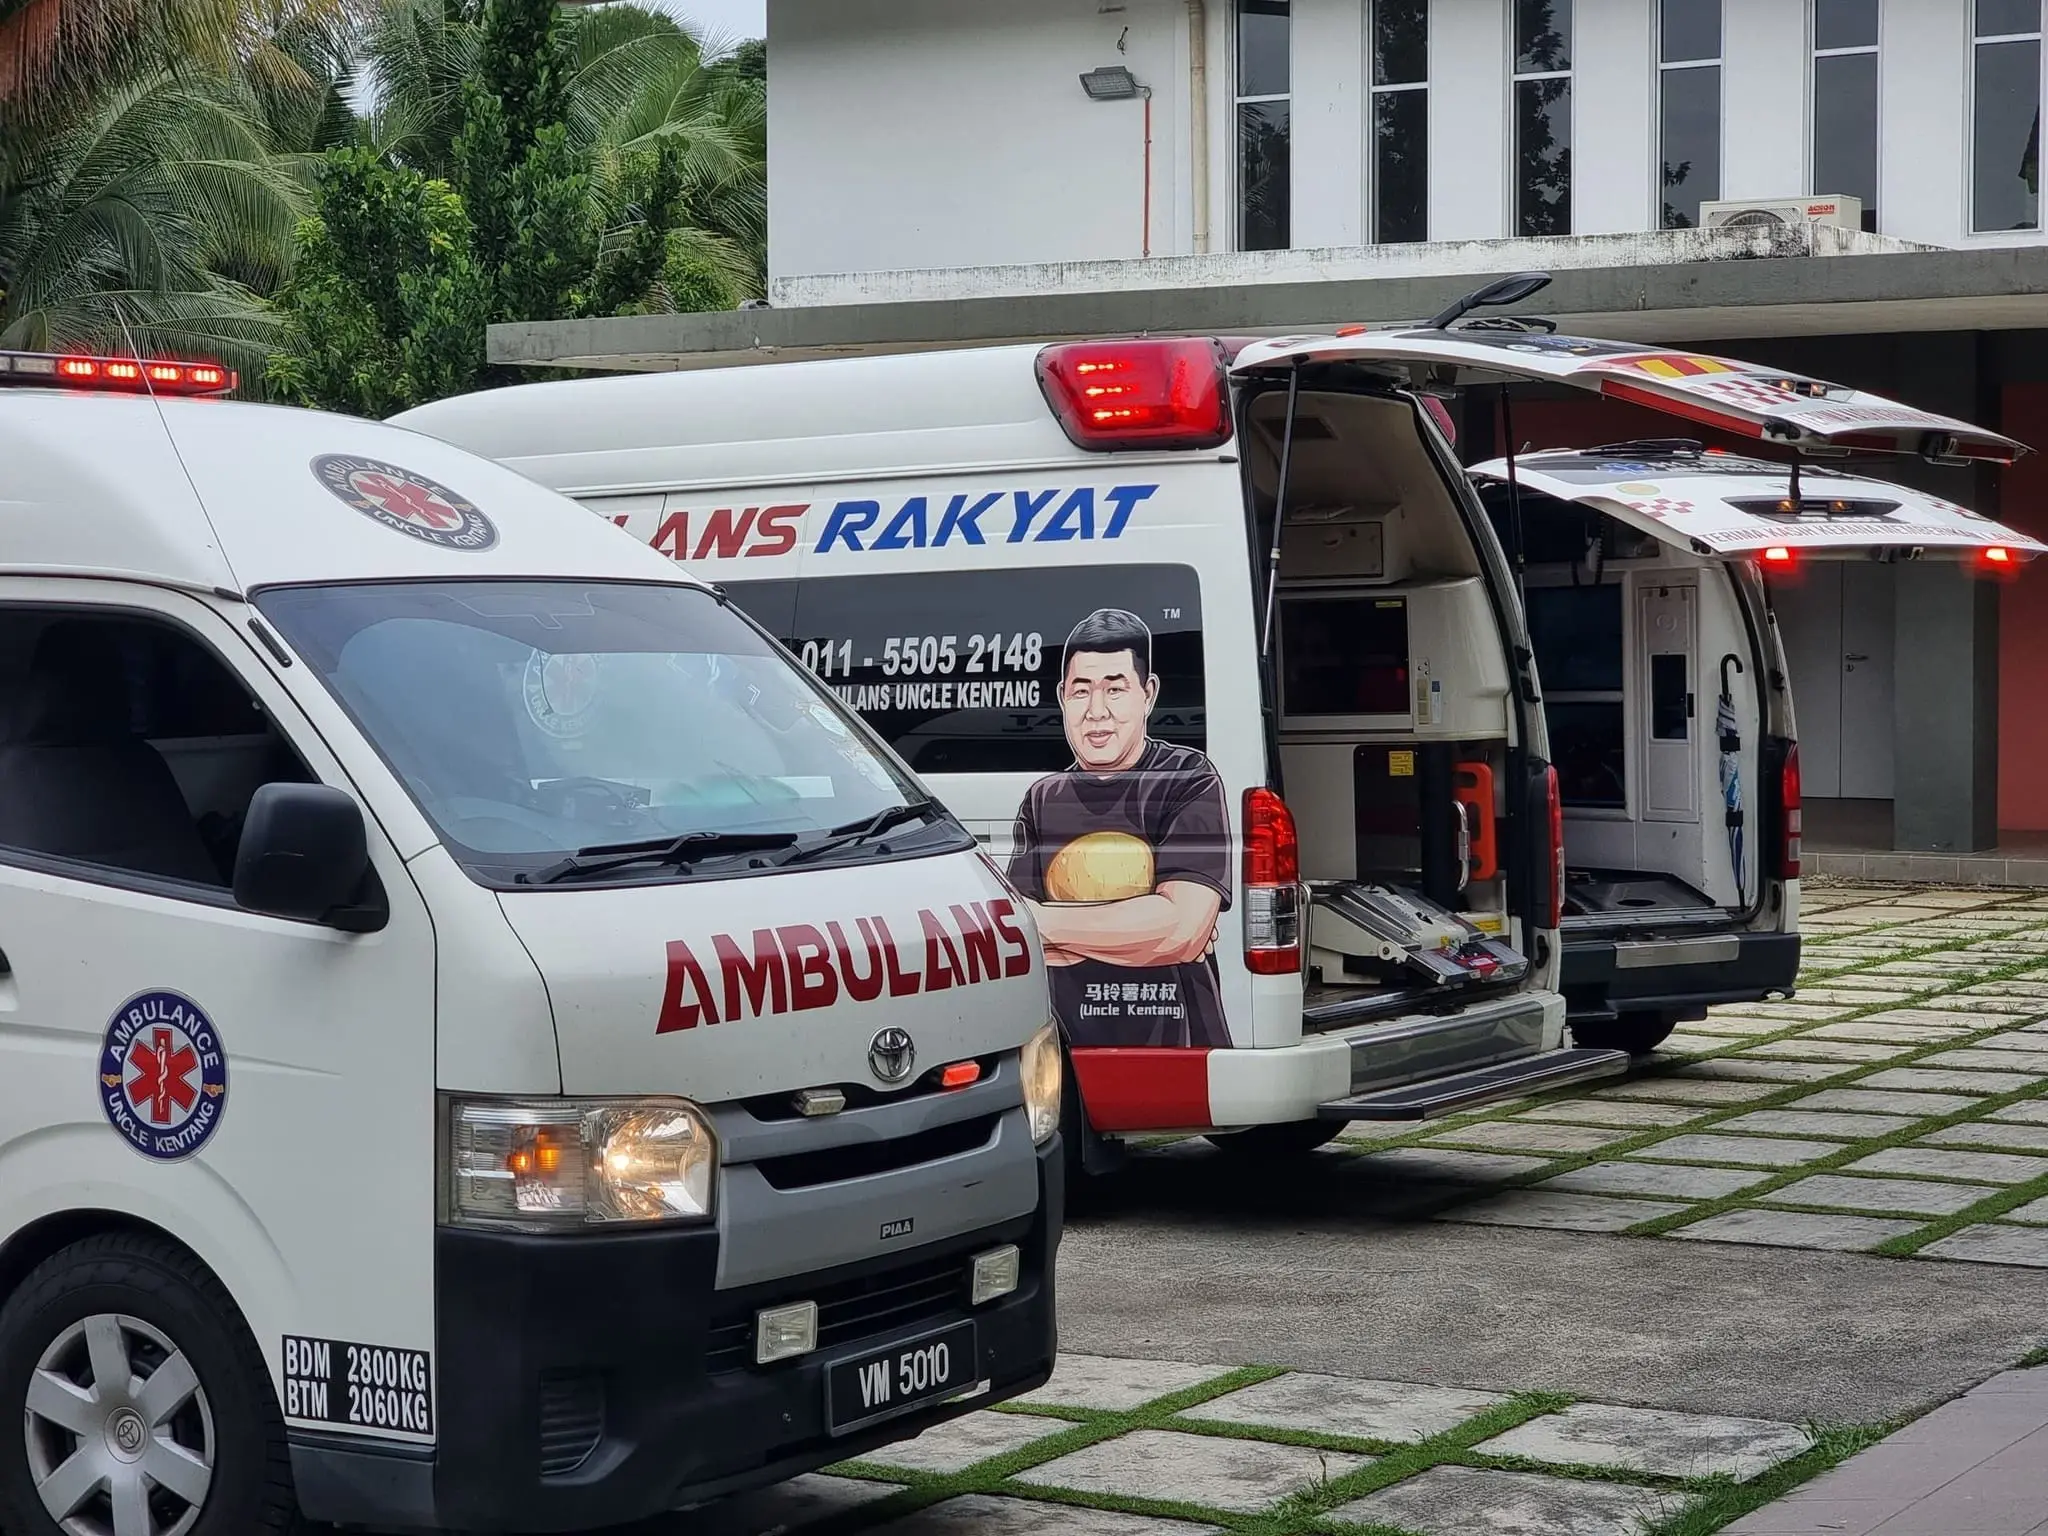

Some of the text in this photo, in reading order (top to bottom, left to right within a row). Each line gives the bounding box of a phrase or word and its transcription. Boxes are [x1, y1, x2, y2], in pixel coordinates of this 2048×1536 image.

[324, 459, 447, 495] AMBULANCE
[374, 510, 488, 547] UNCLE KENTANG
[813, 484, 1160, 554] RAKYAT
[1162, 608, 1181, 620] TM
[801, 639, 852, 677] 011
[882, 636, 957, 676] 5505
[966, 632, 1042, 673] 2148
[895, 682, 952, 709] UNCLE
[957, 679, 1040, 708] KENTANG
[655, 899, 1031, 1035] AMBULANS
[1080, 1003, 1184, 1019] (Uncle Kentang)
[1085, 983, 1177, 1001] 马铃薯叔叔
[110, 1000, 219, 1069] AMBULANCE
[109, 1092, 215, 1153] UNCLE KENTANG
[882, 1220, 912, 1238] PIAA
[286, 1338, 426, 1391] BDM 2800KG
[859, 1342, 949, 1408] VM 5010
[287, 1378, 428, 1431] BTM 2060KG
